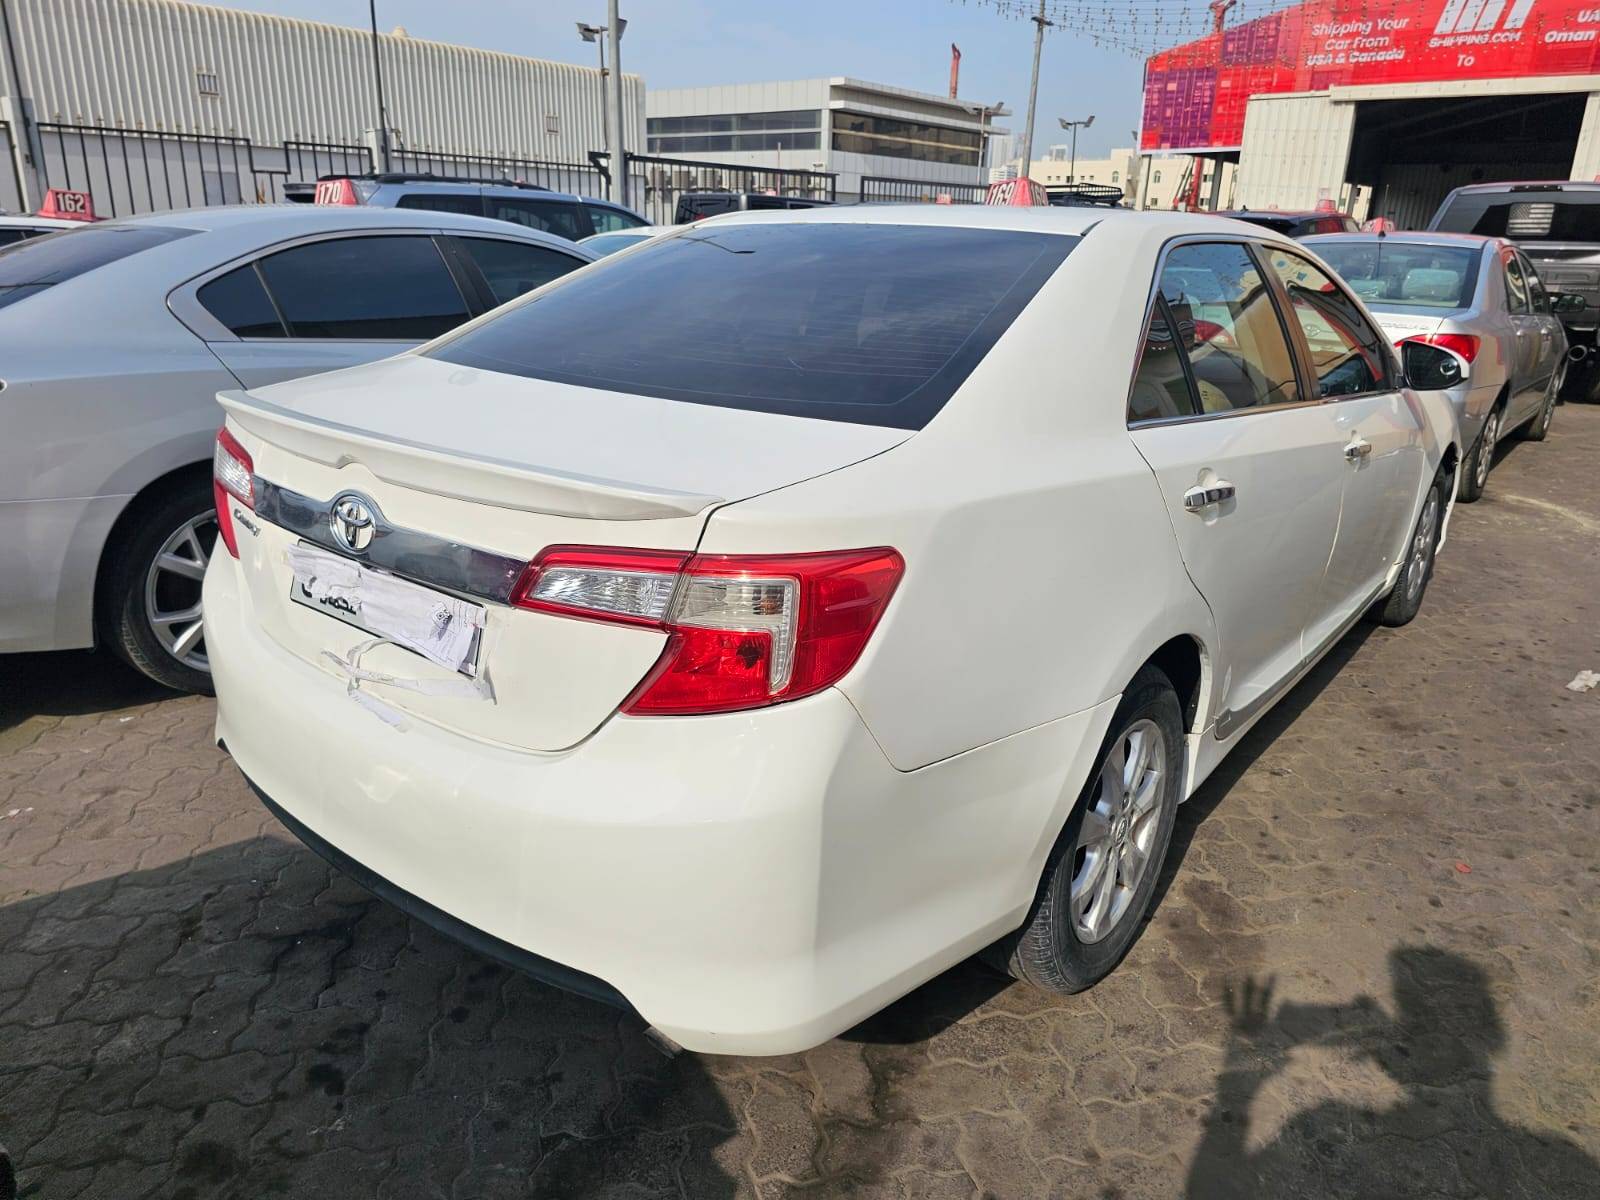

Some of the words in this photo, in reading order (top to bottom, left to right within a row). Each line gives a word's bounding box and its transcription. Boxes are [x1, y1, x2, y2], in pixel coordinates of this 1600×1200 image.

[1312, 20, 1372, 37] Shipping
[1377, 18, 1409, 31] Your
[1545, 30, 1596, 43] Oman
[1325, 38, 1351, 51] Car
[1353, 36, 1389, 49] From
[1307, 52, 1332, 65] USA
[1349, 48, 1404, 63] Canada
[1457, 54, 1475, 67] To
[319, 182, 342, 205] 170
[989, 181, 1016, 206] 169
[56, 192, 85, 214] 162
